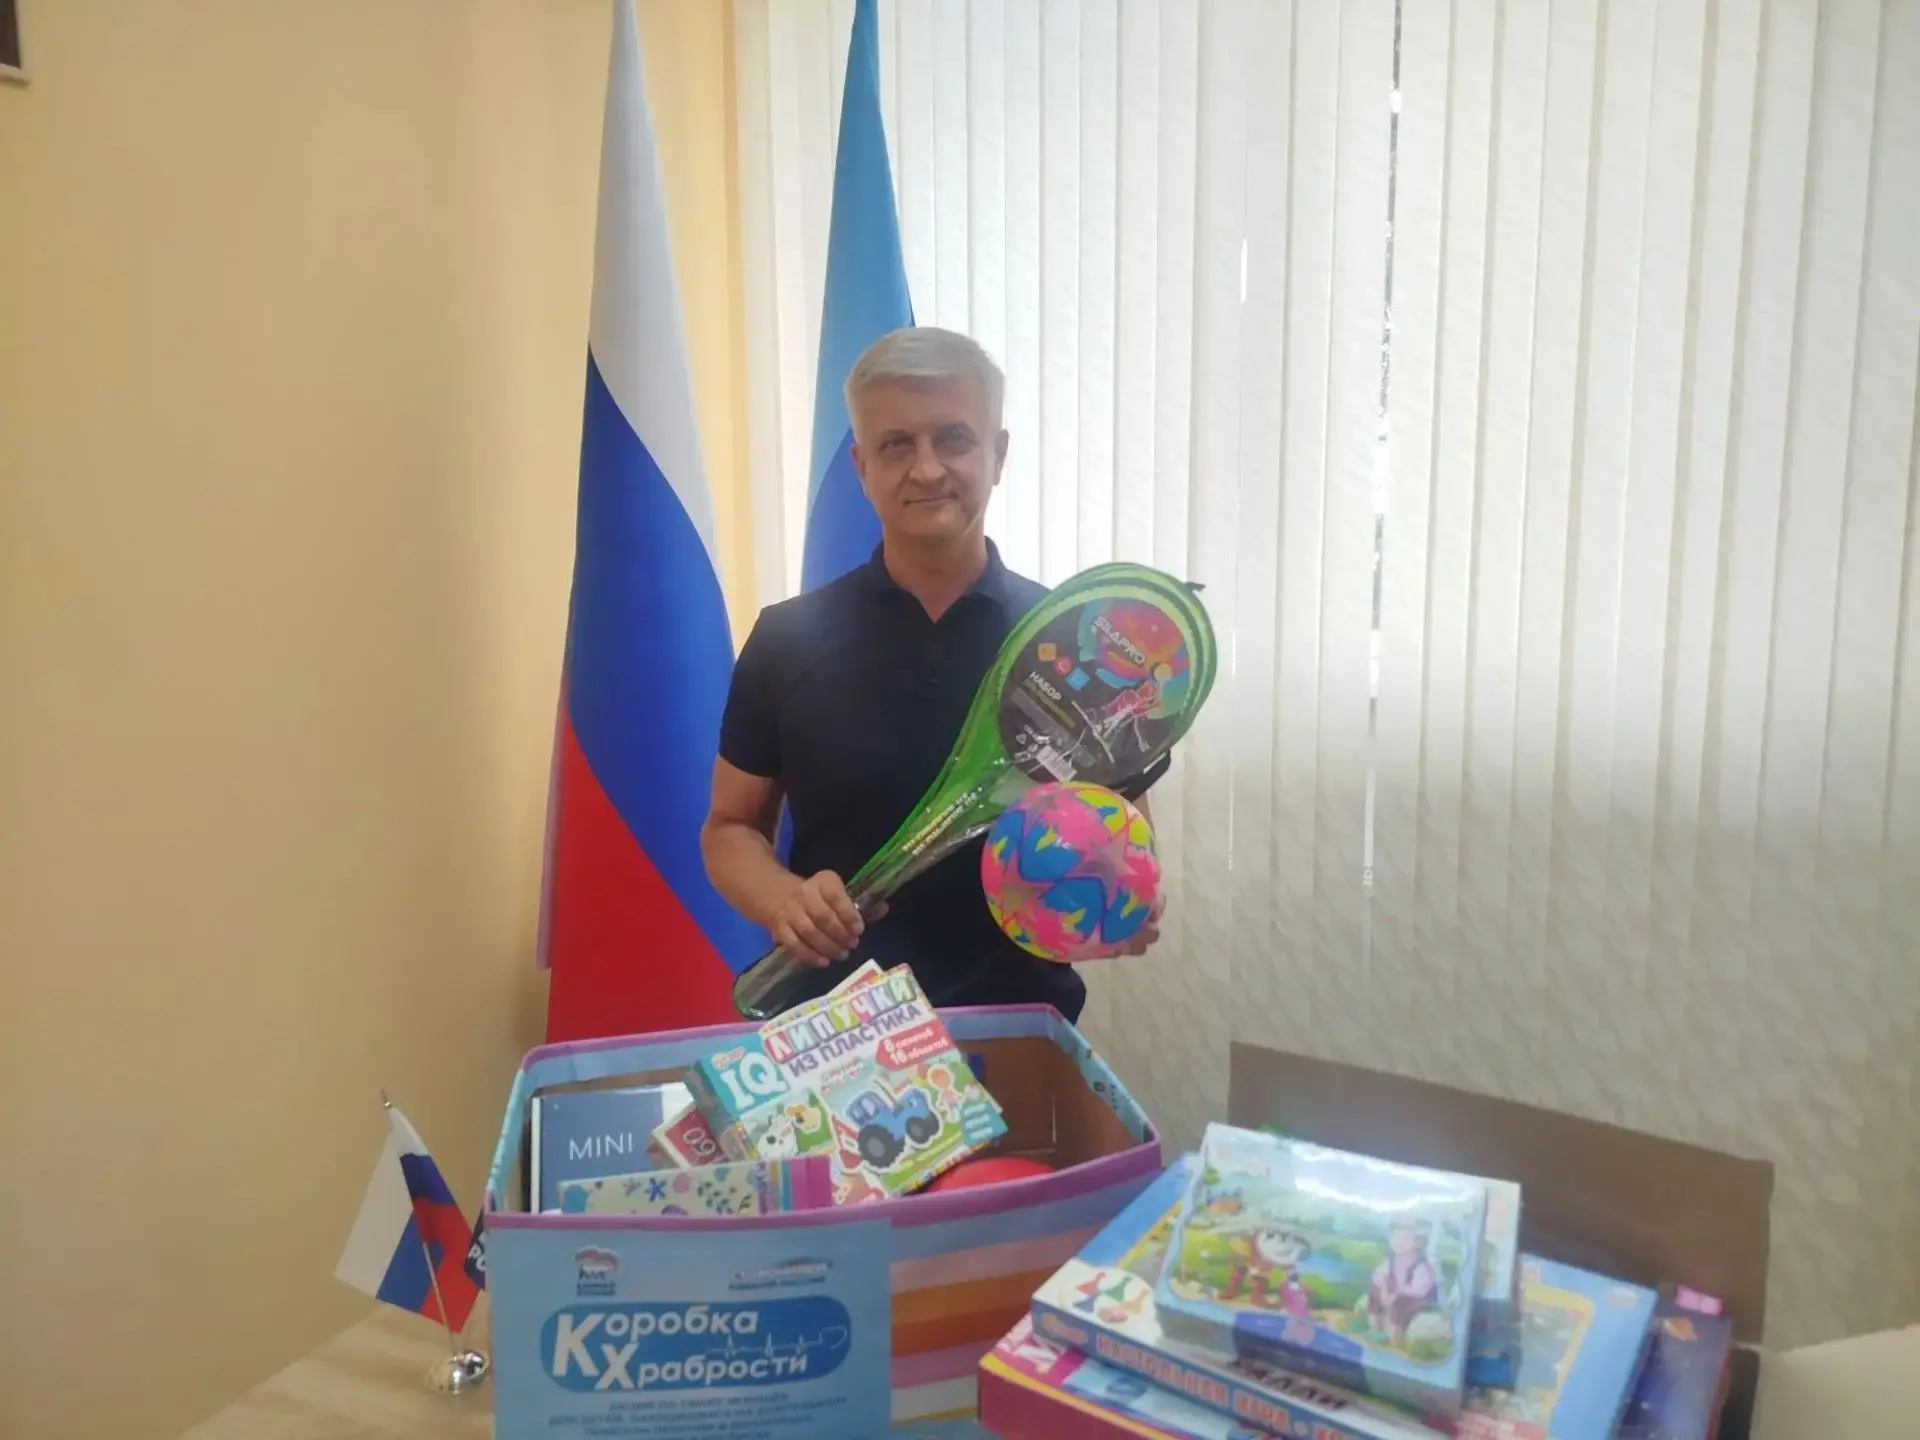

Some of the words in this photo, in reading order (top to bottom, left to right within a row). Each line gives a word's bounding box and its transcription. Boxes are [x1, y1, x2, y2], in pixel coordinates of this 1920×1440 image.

[1029, 671, 1062, 701] НАБОР
[764, 973, 917, 1062] ЛИПУЧКИ
[788, 1053, 818, 1077] ИЗ
[822, 1004, 923, 1064] ПЛАСТИКА
[720, 1051, 790, 1111] IQ
[568, 1132, 633, 1160] MINI
[552, 1305, 759, 1377] Коробка
[595, 1343, 808, 1390] Храбрости
